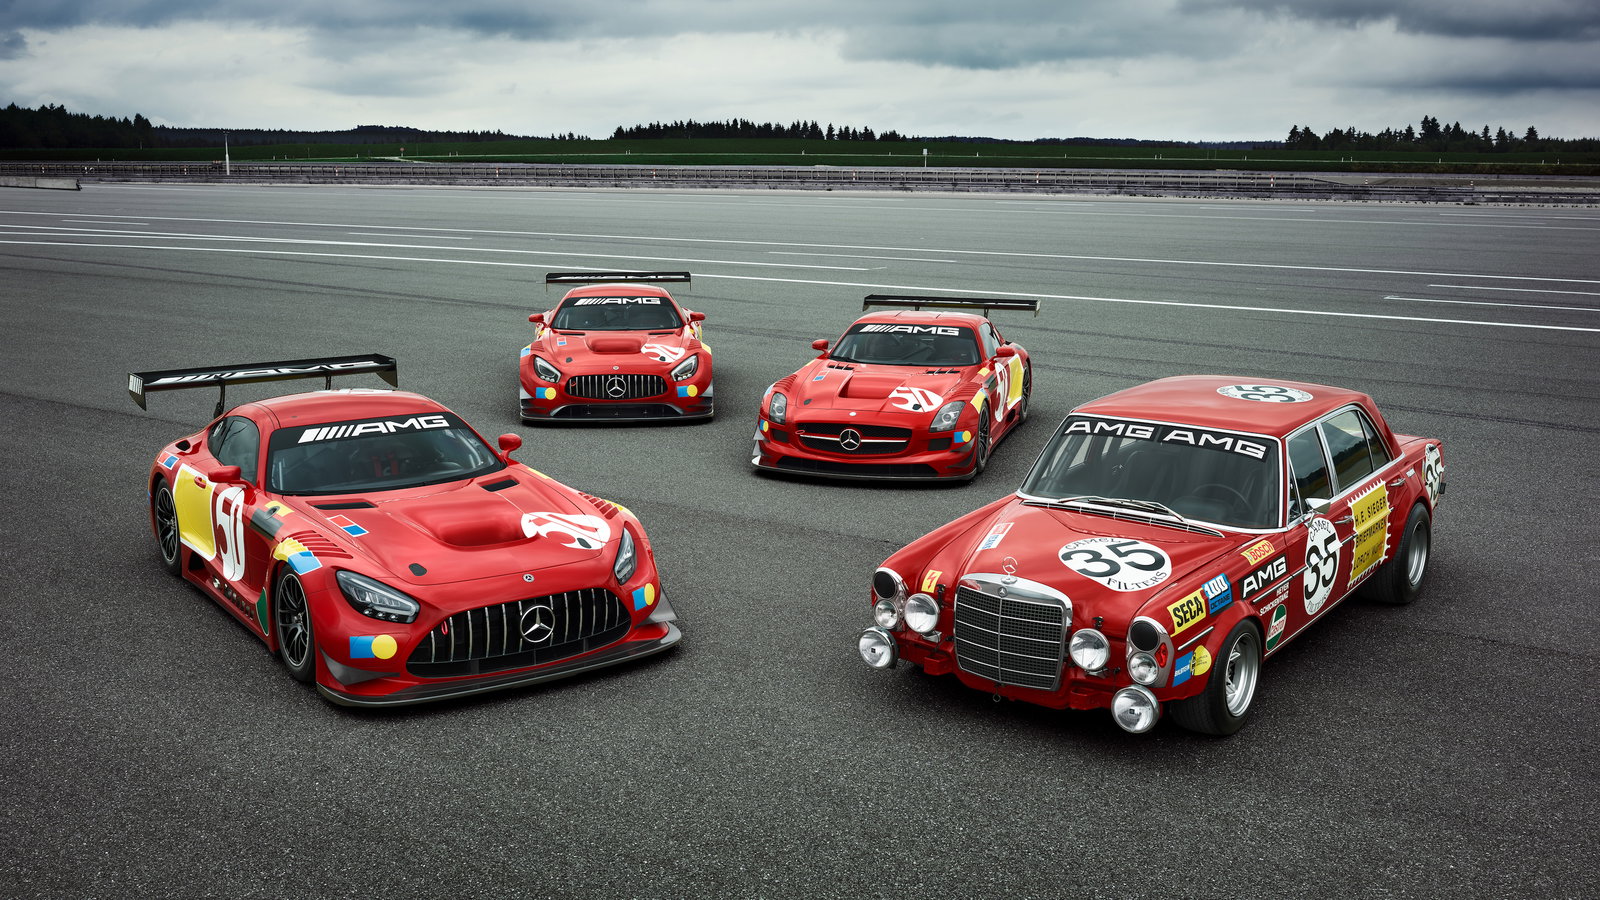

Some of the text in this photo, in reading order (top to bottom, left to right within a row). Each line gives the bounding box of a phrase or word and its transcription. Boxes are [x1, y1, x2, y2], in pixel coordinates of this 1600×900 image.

[892, 325, 960, 337] AMG
[889, 386, 944, 413] 50
[1234, 384, 1296, 403] 35
[351, 415, 450, 437] AMG
[1064, 421, 1267, 460] AMG AMG
[1367, 496, 1387, 518] SIEGER
[215, 486, 245, 581] 50
[520, 511, 611, 550] 50
[1309, 518, 1332, 543] CAMEL
[1065, 537, 1121, 551] CAMEL
[1249, 541, 1275, 561] BOSCH
[1061, 540, 1166, 578] 35
[1304, 532, 1338, 601] 35
[1106, 571, 1168, 591] FILTERS
[1203, 575, 1229, 600] 100
[1242, 555, 1288, 599] AMG
[1172, 596, 1205, 628] SECA
[1210, 593, 1231, 611] OCTANE
